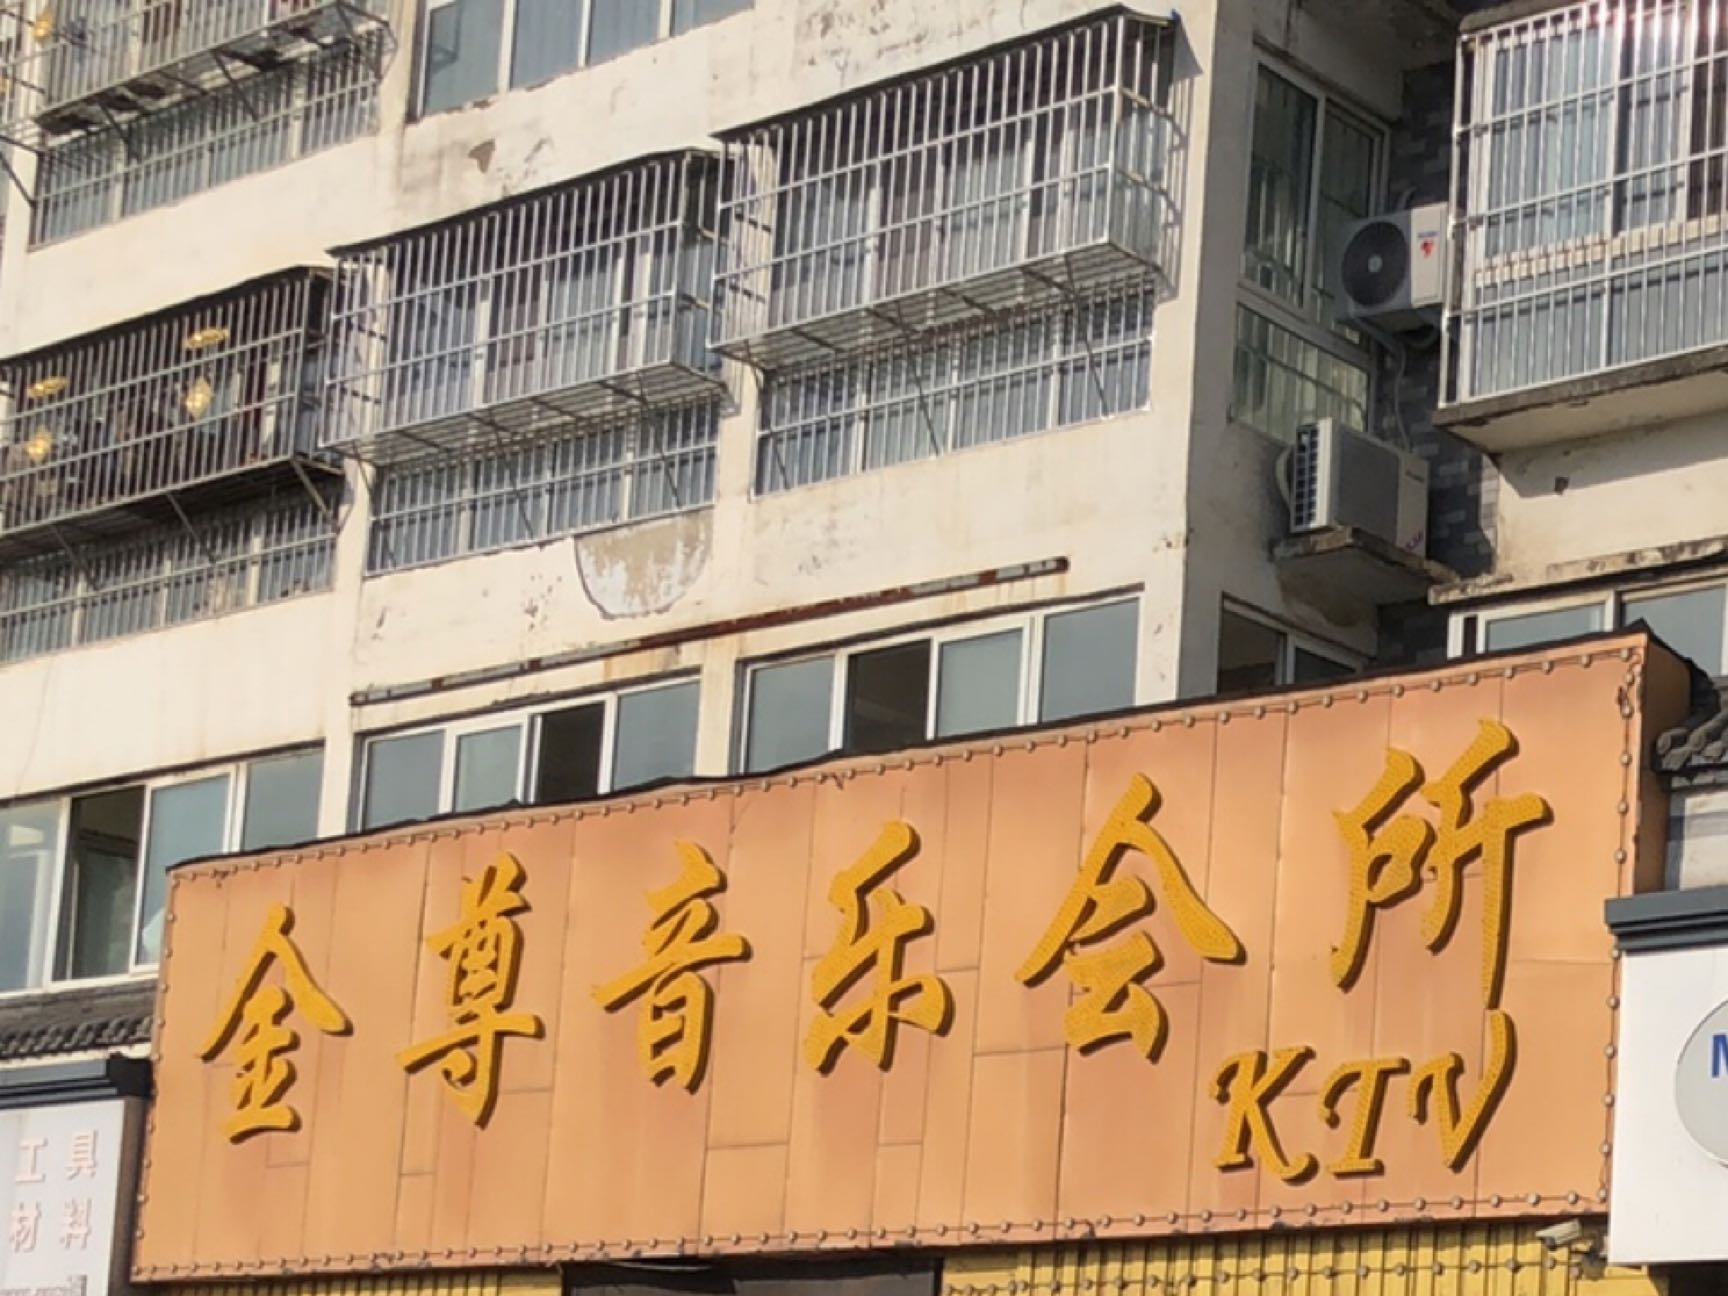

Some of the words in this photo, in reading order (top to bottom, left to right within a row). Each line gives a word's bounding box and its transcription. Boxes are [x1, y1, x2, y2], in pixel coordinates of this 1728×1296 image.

[199, 715, 1554, 1145] 金尊音乐会所
[15, 1128, 98, 1184] 工具
[1208, 1010, 1518, 1186] KTV
